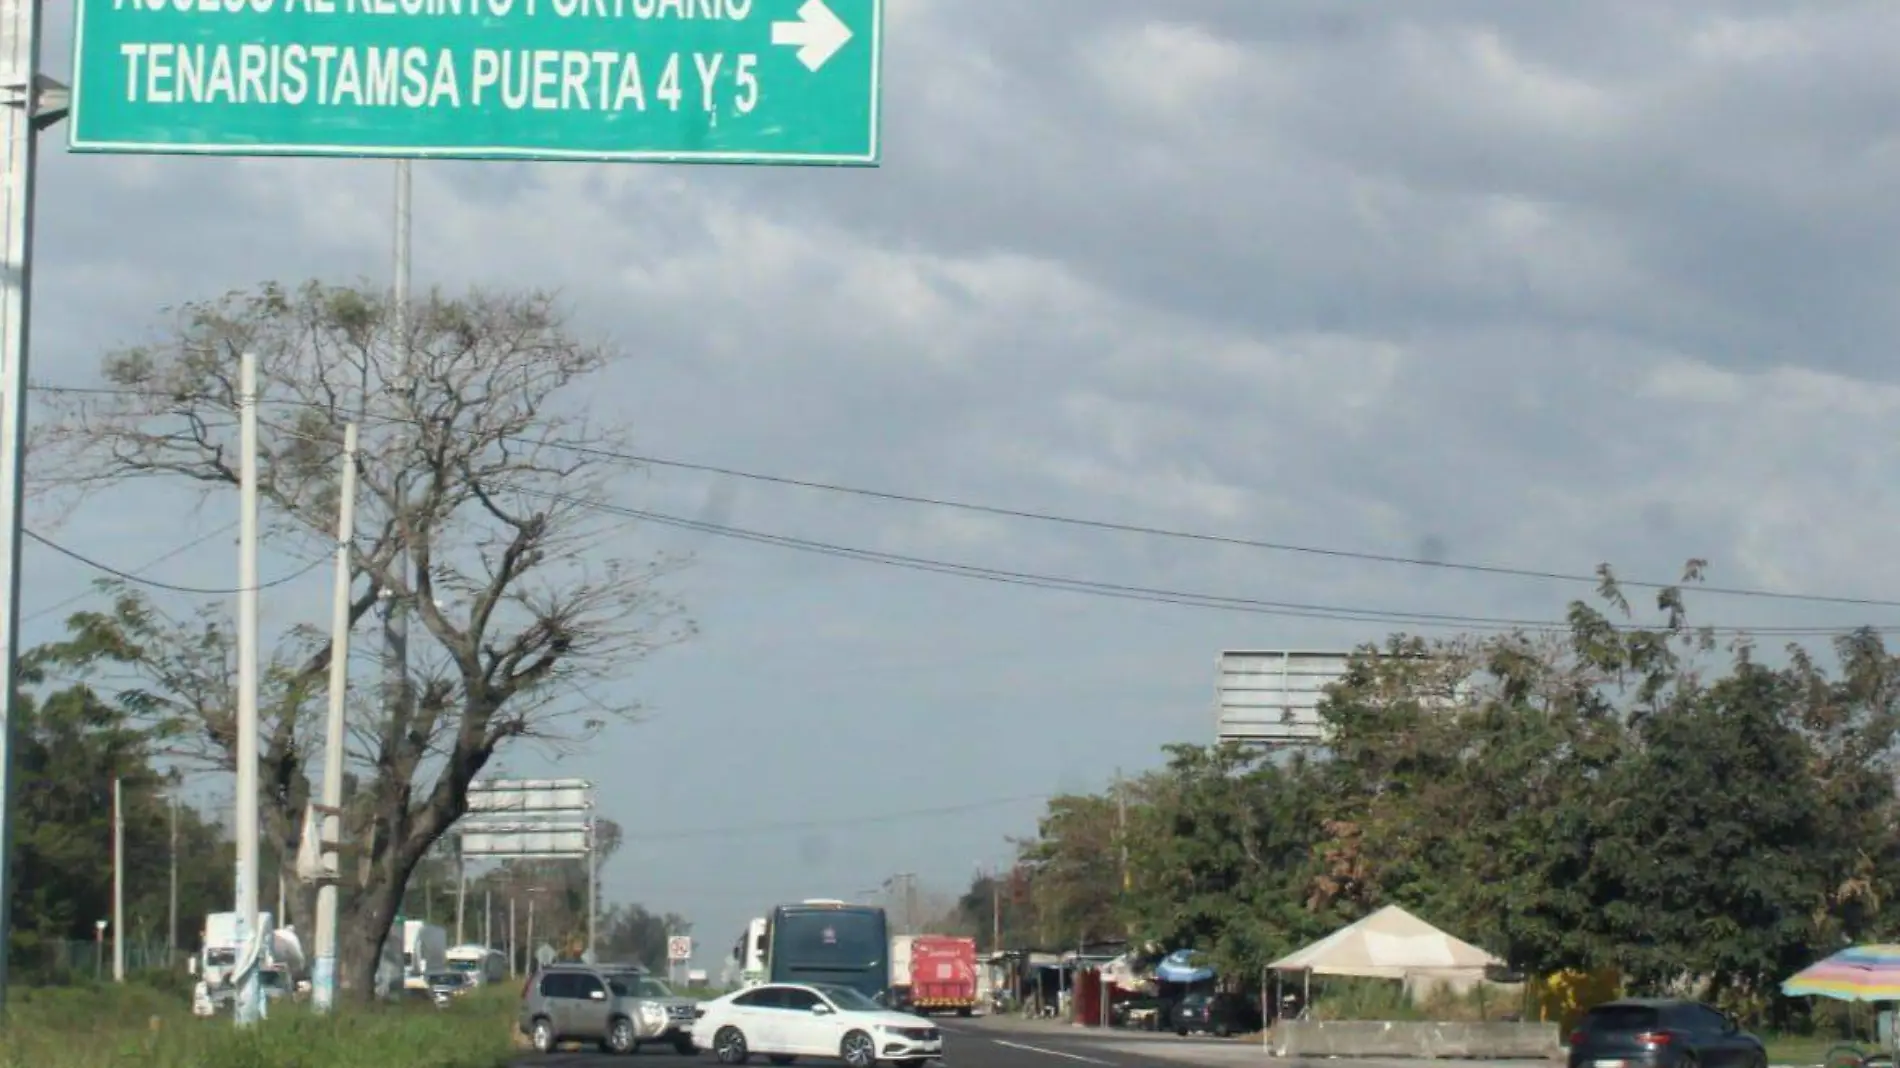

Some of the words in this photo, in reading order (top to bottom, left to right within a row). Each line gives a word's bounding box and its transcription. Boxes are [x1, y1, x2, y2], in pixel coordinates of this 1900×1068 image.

[120, 43, 460, 107] TENARISTAMSA
[471, 48, 646, 111] PUERTA
[656, 52, 682, 111] 4
[693, 52, 723, 112] Y
[735, 53, 758, 112] 5
